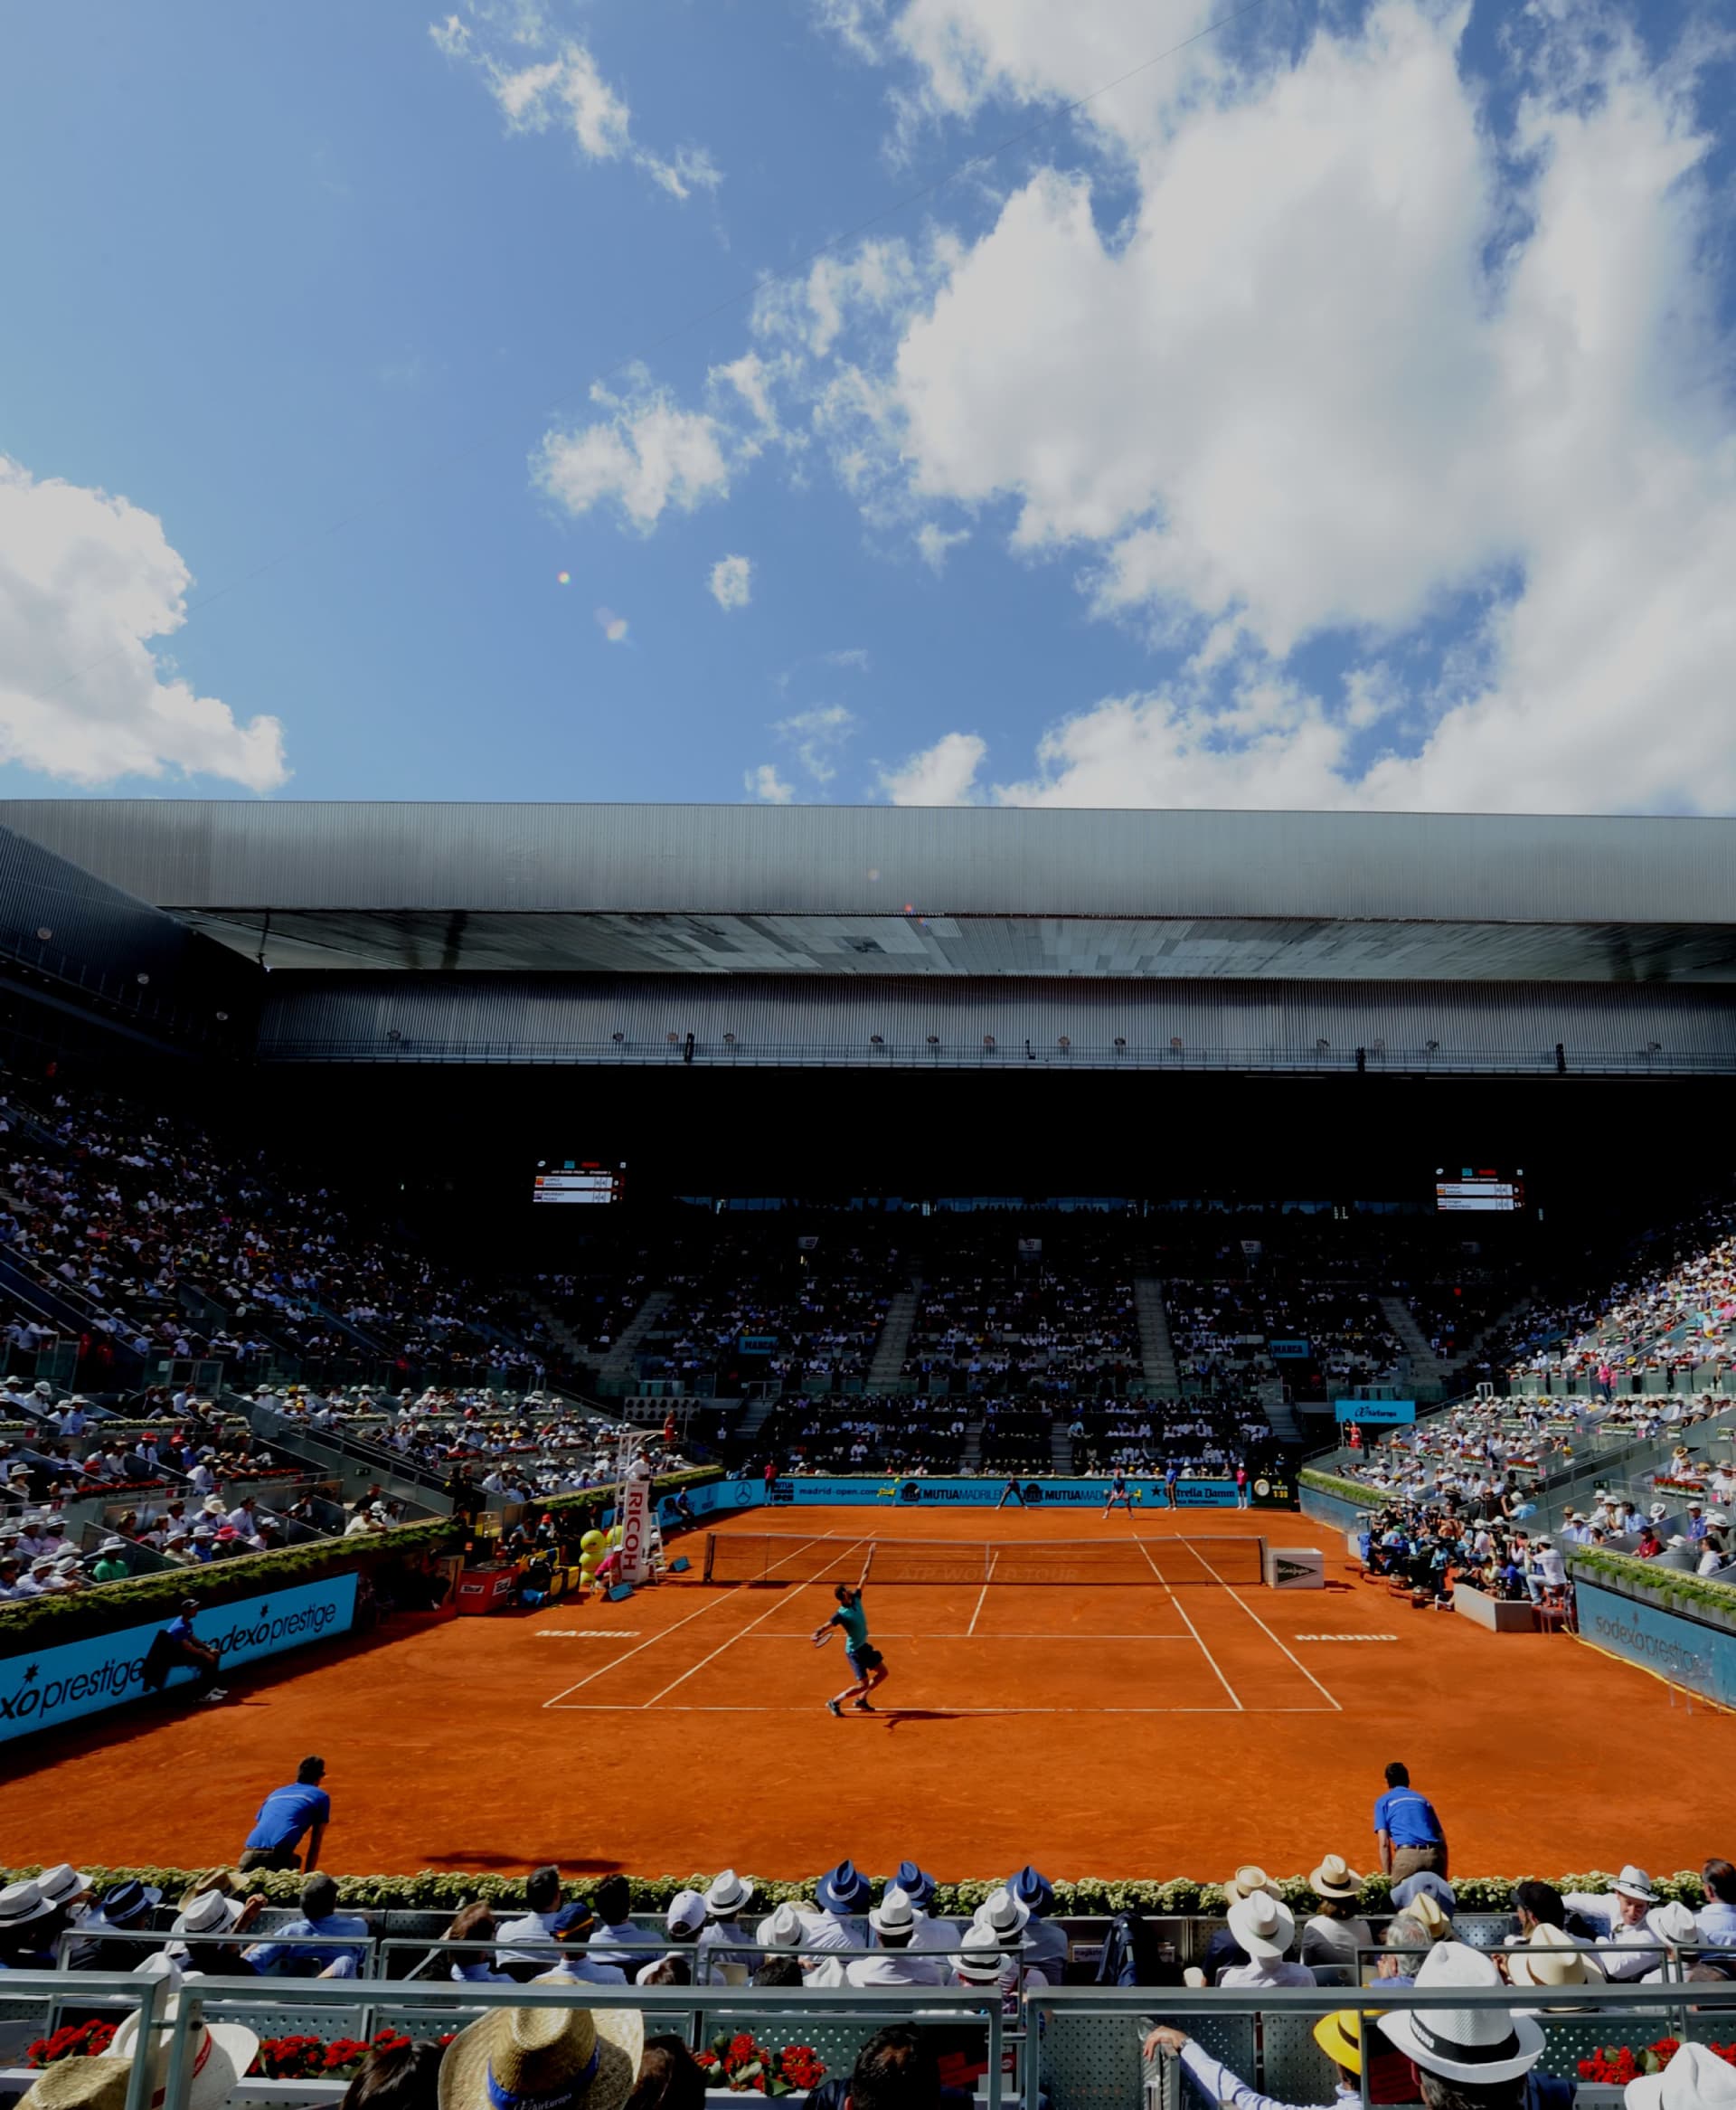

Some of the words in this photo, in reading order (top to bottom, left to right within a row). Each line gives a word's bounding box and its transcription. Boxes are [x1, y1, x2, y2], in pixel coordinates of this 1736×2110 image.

[622, 1492, 643, 1570] RICOH
[269, 1602, 337, 1644] prestige
[40, 1657, 146, 1719] prestige
